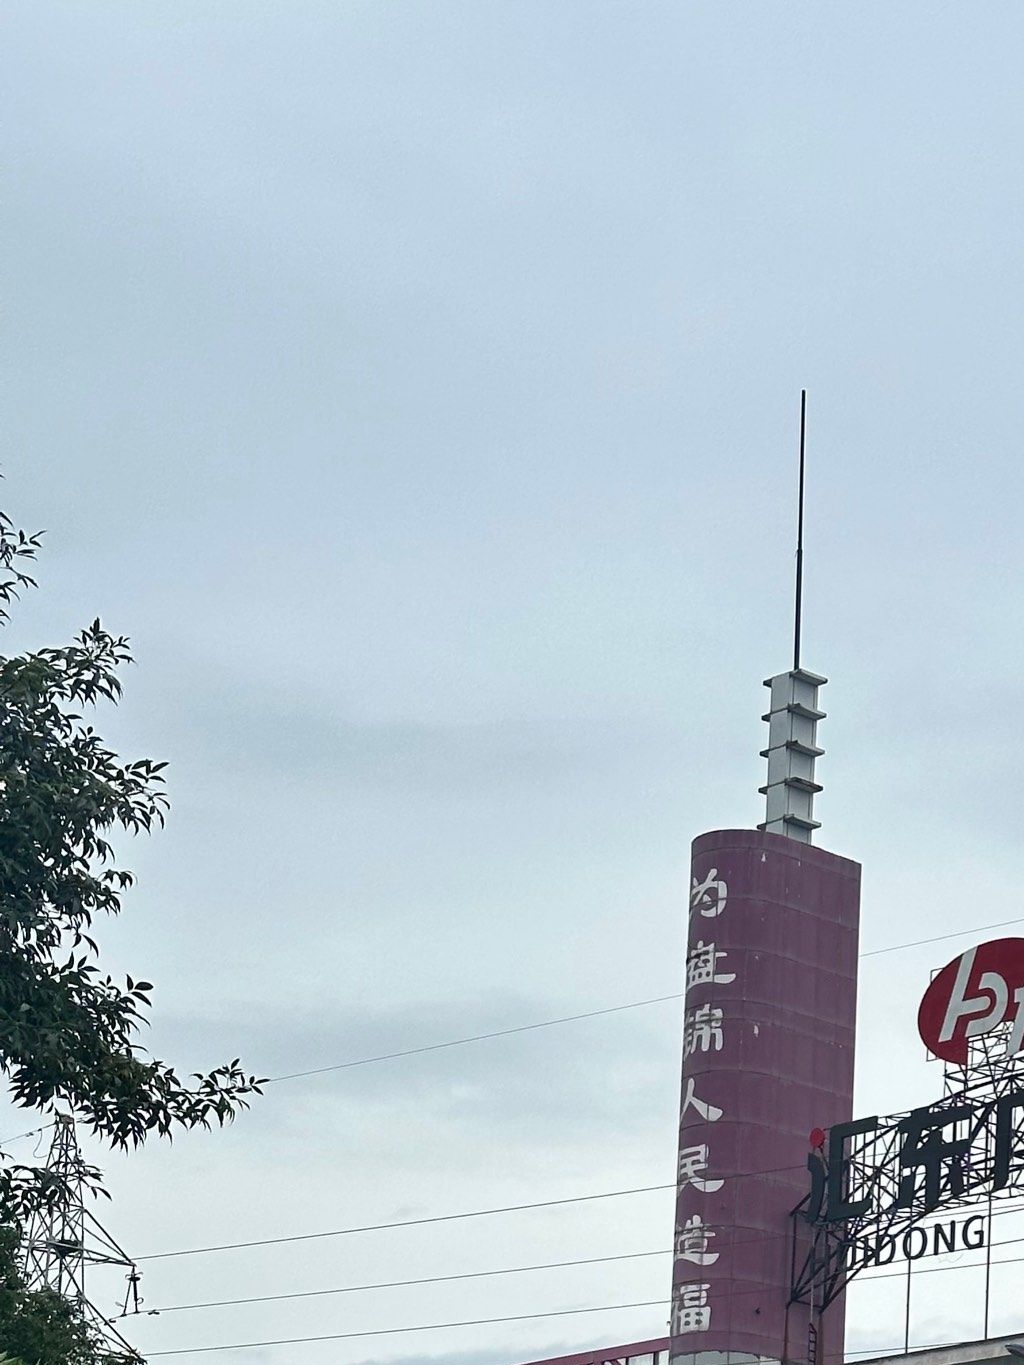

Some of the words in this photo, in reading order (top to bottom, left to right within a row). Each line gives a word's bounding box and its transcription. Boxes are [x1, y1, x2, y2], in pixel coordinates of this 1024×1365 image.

[671, 868, 736, 1336] 为盘锦人民造福
